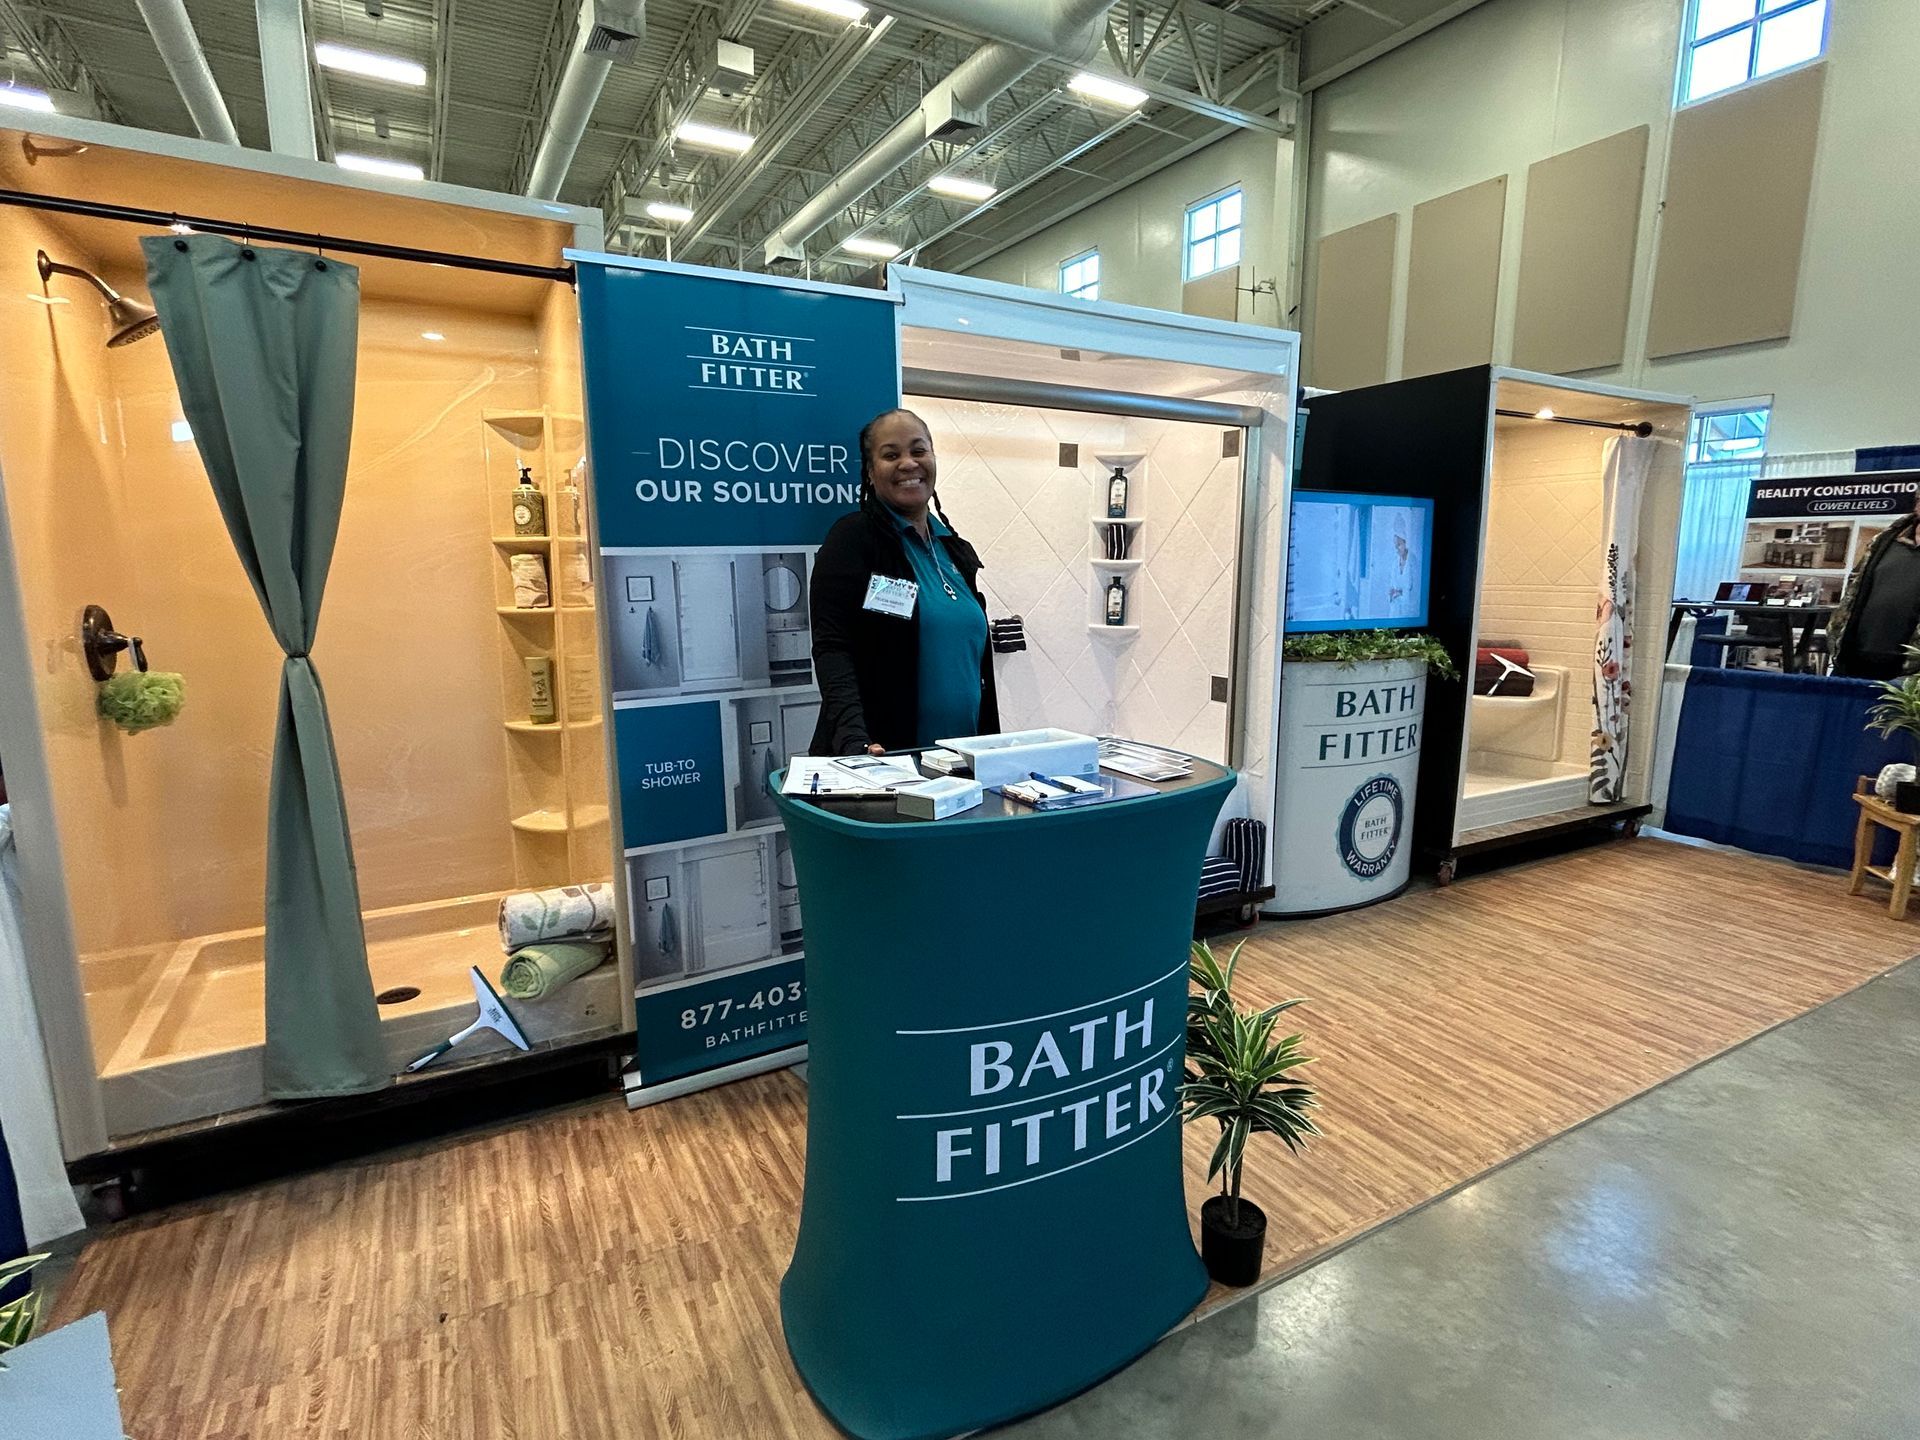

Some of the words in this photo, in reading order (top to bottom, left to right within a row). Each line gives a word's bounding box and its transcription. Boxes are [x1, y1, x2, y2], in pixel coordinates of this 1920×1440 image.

[712, 334, 793, 361] BATH
[701, 362, 804, 391] FITTER
[658, 437, 849, 474] DISCOVER
[635, 478, 703, 503] OUR
[1756, 487, 1812, 499] REALITY
[1813, 482, 1918, 497] CONSTRUCTIO
[1813, 501, 1851, 511] LOWER
[1851, 500, 1889, 510] LEVELS
[1336, 685, 1416, 718] BATH
[1319, 724, 1417, 761] FITTER
[641, 772, 702, 790] SHOWER
[645, 759, 696, 775] TUB-TO
[1354, 780, 1399, 807] LIFETIME
[1360, 827, 1389, 840] FITTER
[1364, 816, 1387, 828] BATH
[1346, 840, 1396, 875] WARRANTY
[680, 981, 808, 1030] 877-403
[705, 1010, 809, 1049] BATHFITTE
[969, 997, 1155, 1097] BATH
[936, 1067, 1167, 1183] FITTER
